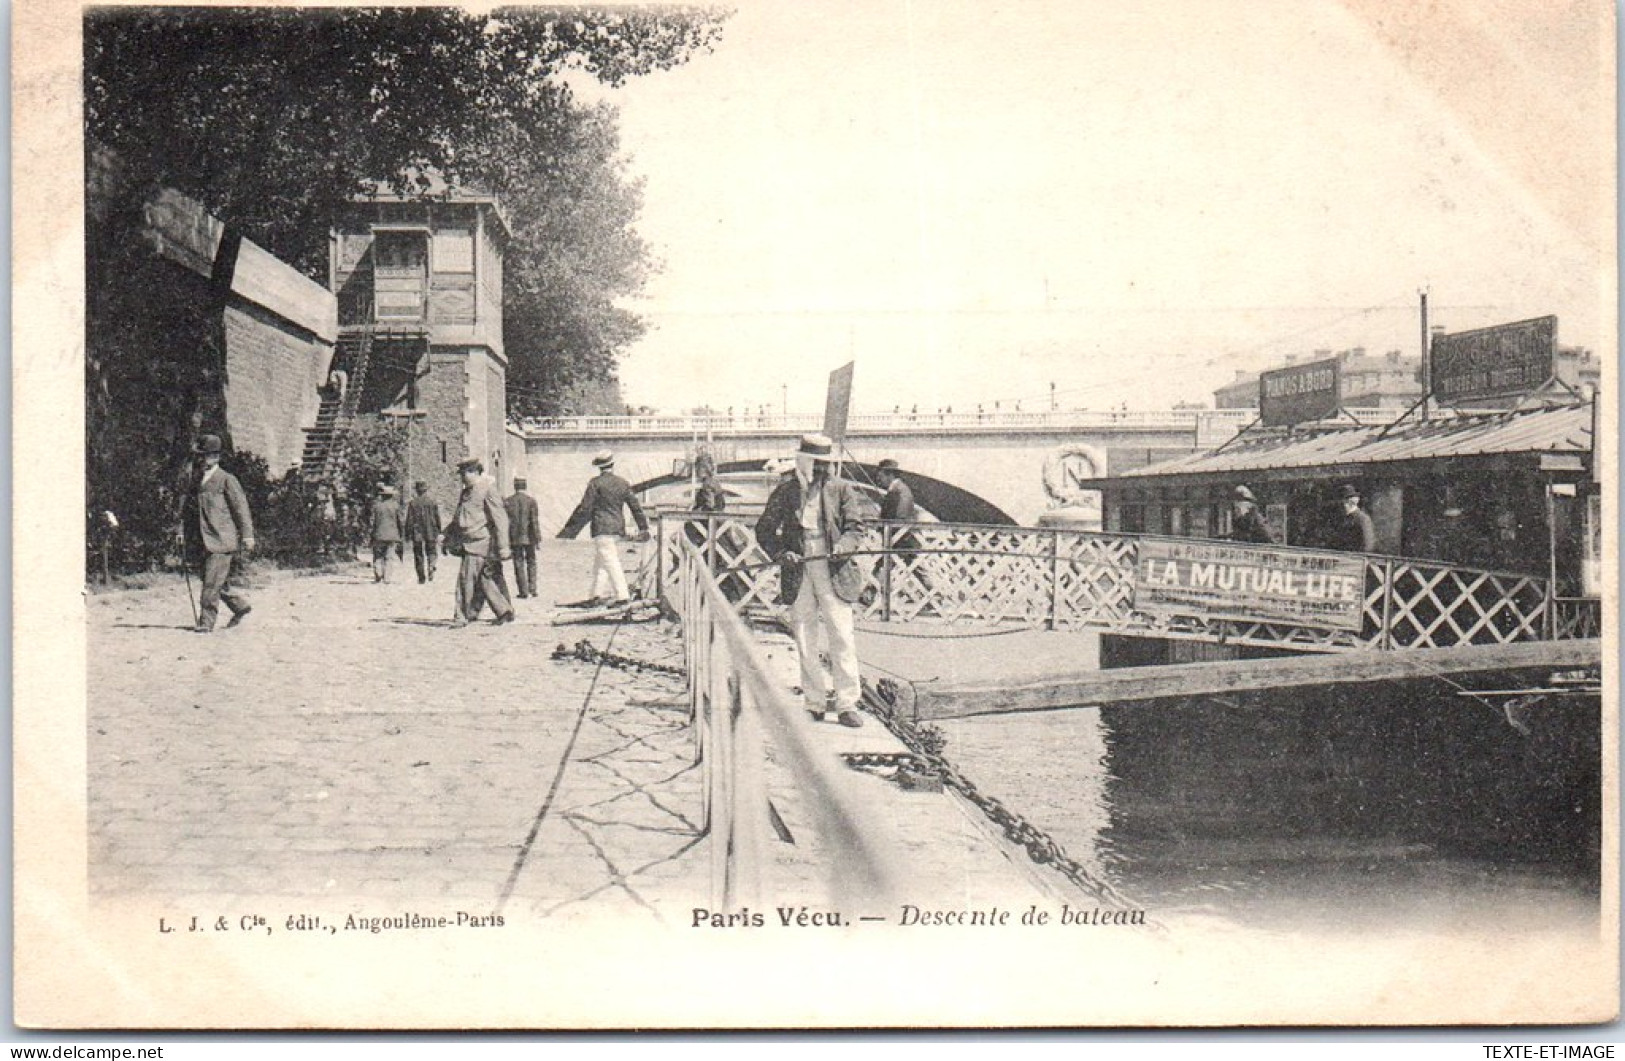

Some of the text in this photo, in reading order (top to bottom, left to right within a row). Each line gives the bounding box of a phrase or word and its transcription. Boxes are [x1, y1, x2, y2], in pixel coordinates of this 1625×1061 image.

[1146, 559, 1180, 586] LA
[1190, 562, 1298, 596] MUTUAL
[1306, 574, 1358, 602] LIFE
